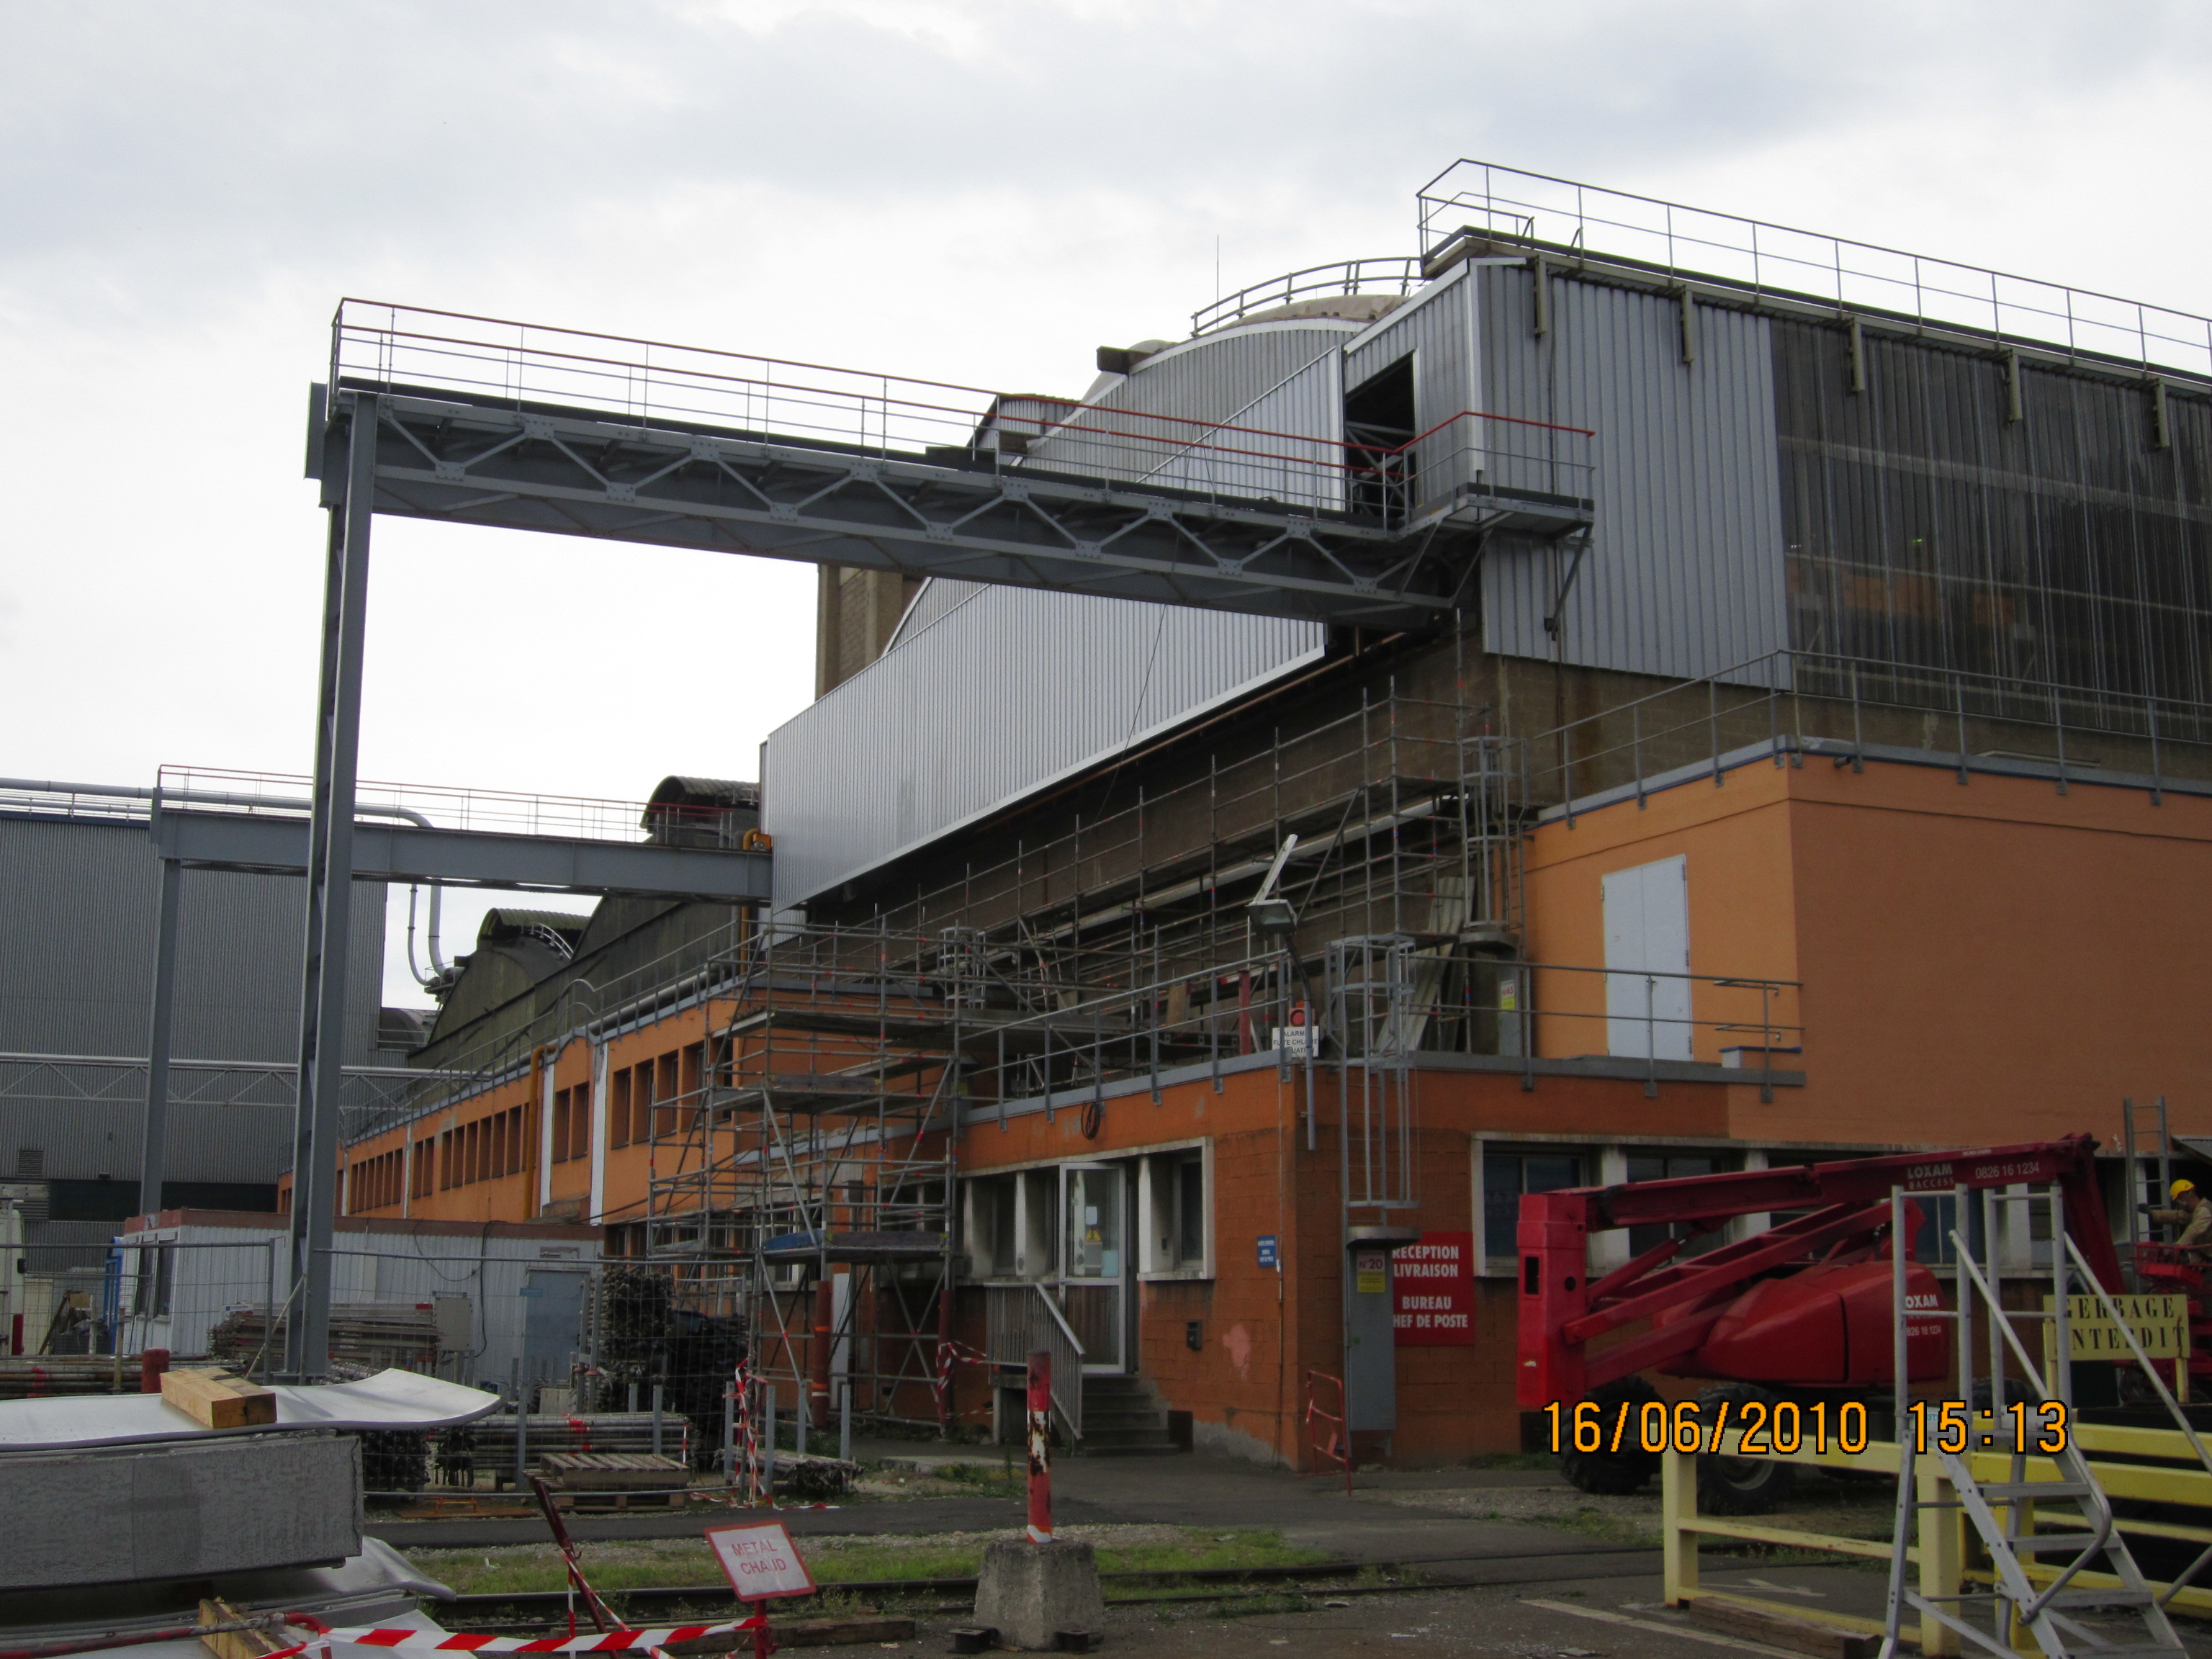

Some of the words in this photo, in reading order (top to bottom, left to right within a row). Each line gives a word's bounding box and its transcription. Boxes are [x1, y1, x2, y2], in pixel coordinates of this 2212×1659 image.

[1907, 1163, 1953, 1179] LOXAM
[1975, 1166, 2000, 1179] 0826
[2002, 1164, 2014, 1176] 16
[2016, 1161, 2040, 1175] 1234
[1917, 1177, 1955, 1189] ACCESS
[1392, 1246, 1459, 1259] RECEPTION
[1393, 1264, 1458, 1277] LIVRAISON
[1402, 1296, 1452, 1310] BUREAU
[1905, 1294, 1938, 1308] OXAM
[1393, 1314, 1413, 1328] HEF
[1416, 1314, 1431, 1328] DE
[1434, 1314, 1468, 1328] POSTE
[1907, 1326, 1920, 1336] 826
[2072, 1326, 2184, 1350] NTEDIT
[731, 1540, 778, 1556] METAL
